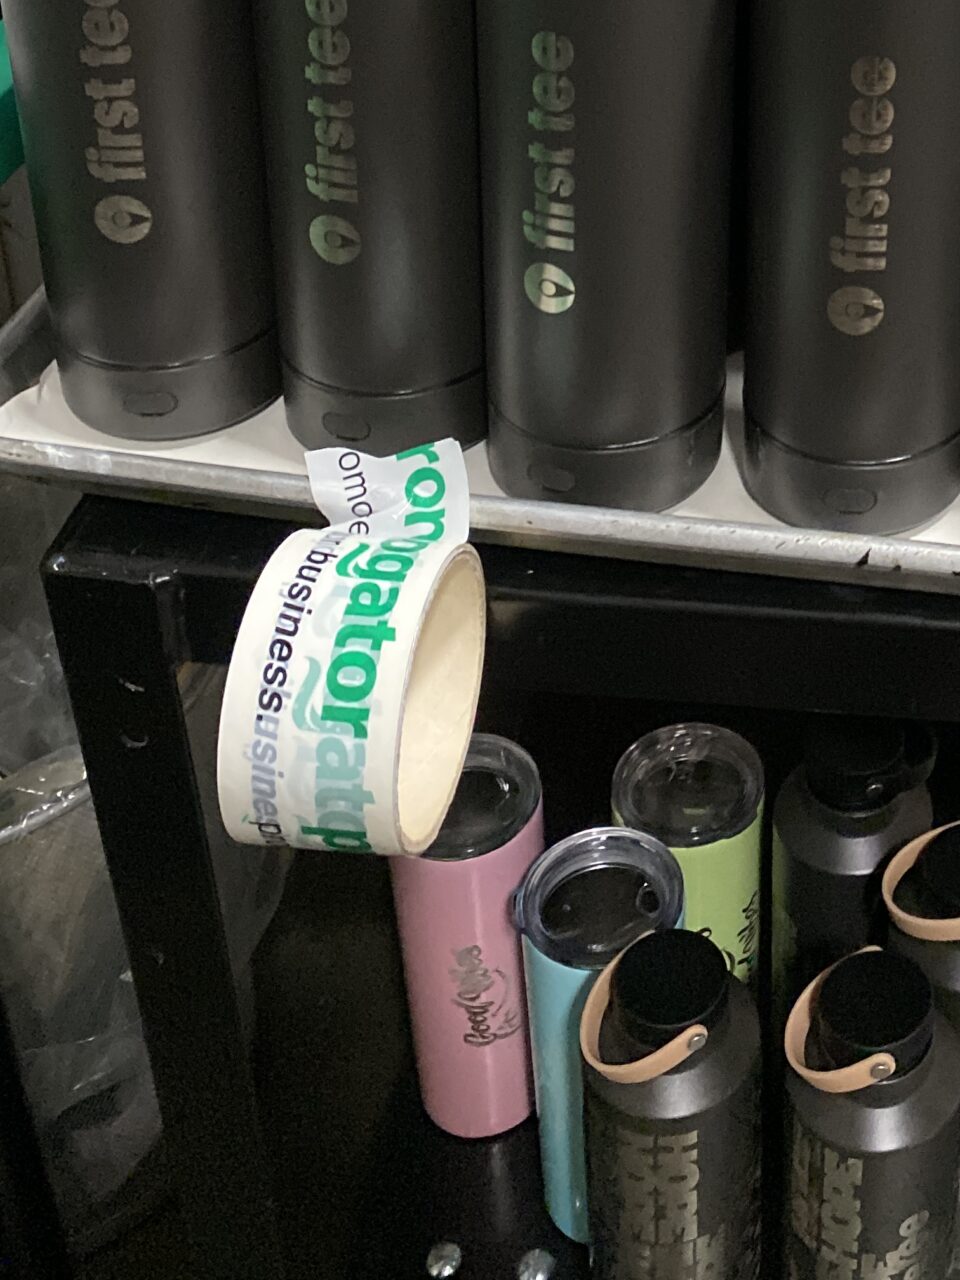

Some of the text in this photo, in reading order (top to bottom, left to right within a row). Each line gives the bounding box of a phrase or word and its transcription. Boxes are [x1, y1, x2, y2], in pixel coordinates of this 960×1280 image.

[84, 78, 147, 183] first
[304, 97, 359, 204] first
[522, 31, 576, 253] first tee
[828, 55, 897, 272] first tee
